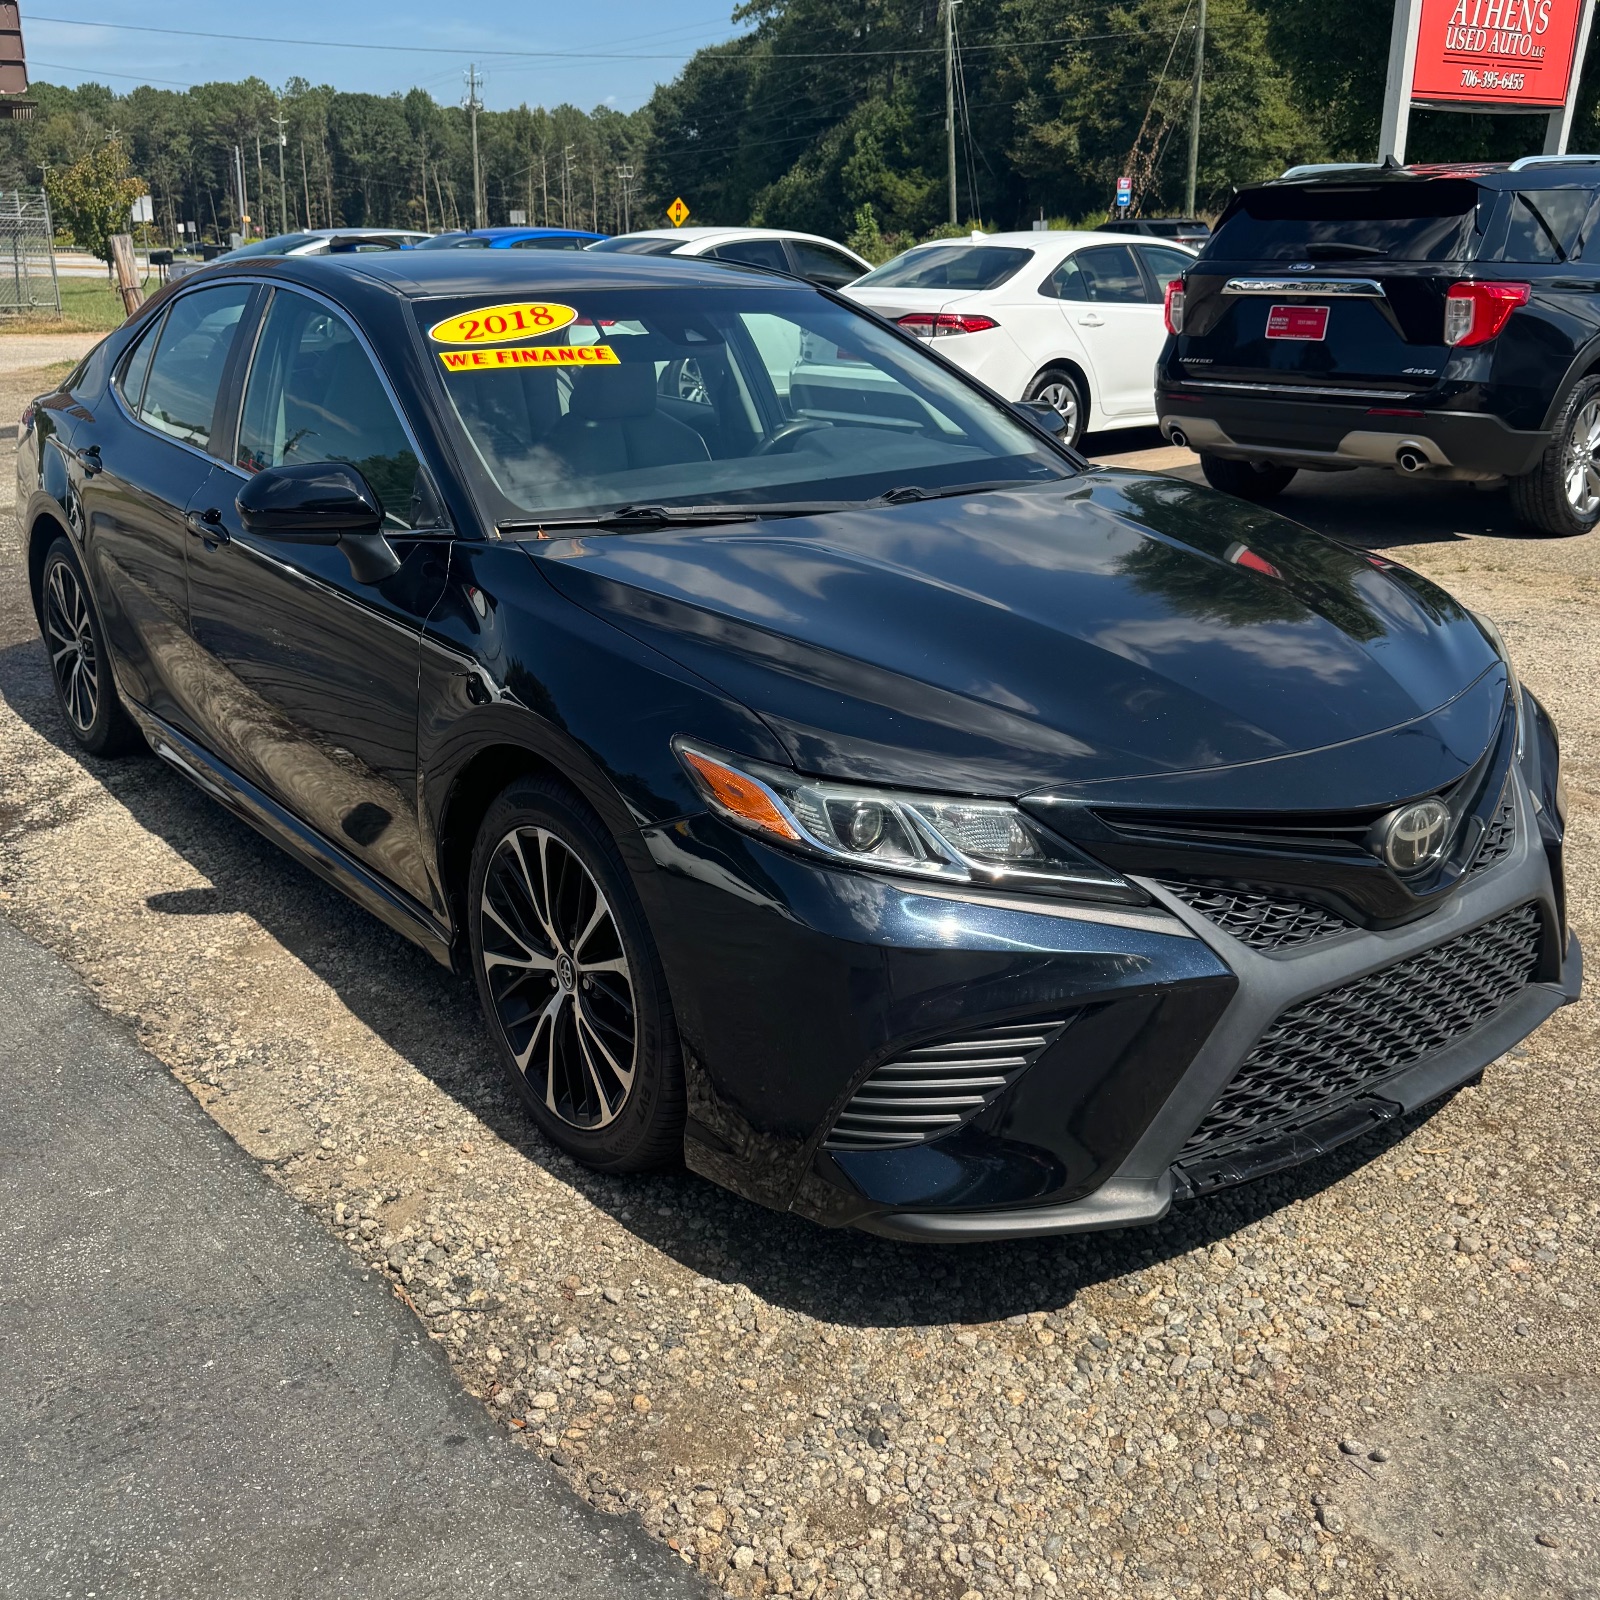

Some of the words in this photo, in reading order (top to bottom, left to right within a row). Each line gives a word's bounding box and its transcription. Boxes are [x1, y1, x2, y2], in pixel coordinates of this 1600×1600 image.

[1448, 0, 1552, 35] ATHENS
[1445, 26, 1487, 52] USED
[1487, 29, 1533, 56] AUTO
[1531, 45, 1546, 58] LLC
[1460, 69, 1525, 91] 706-395-6455
[458, 306, 555, 341] 2018
[444, 352, 489, 367] WE
[496, 347, 611, 364] FINANCE
